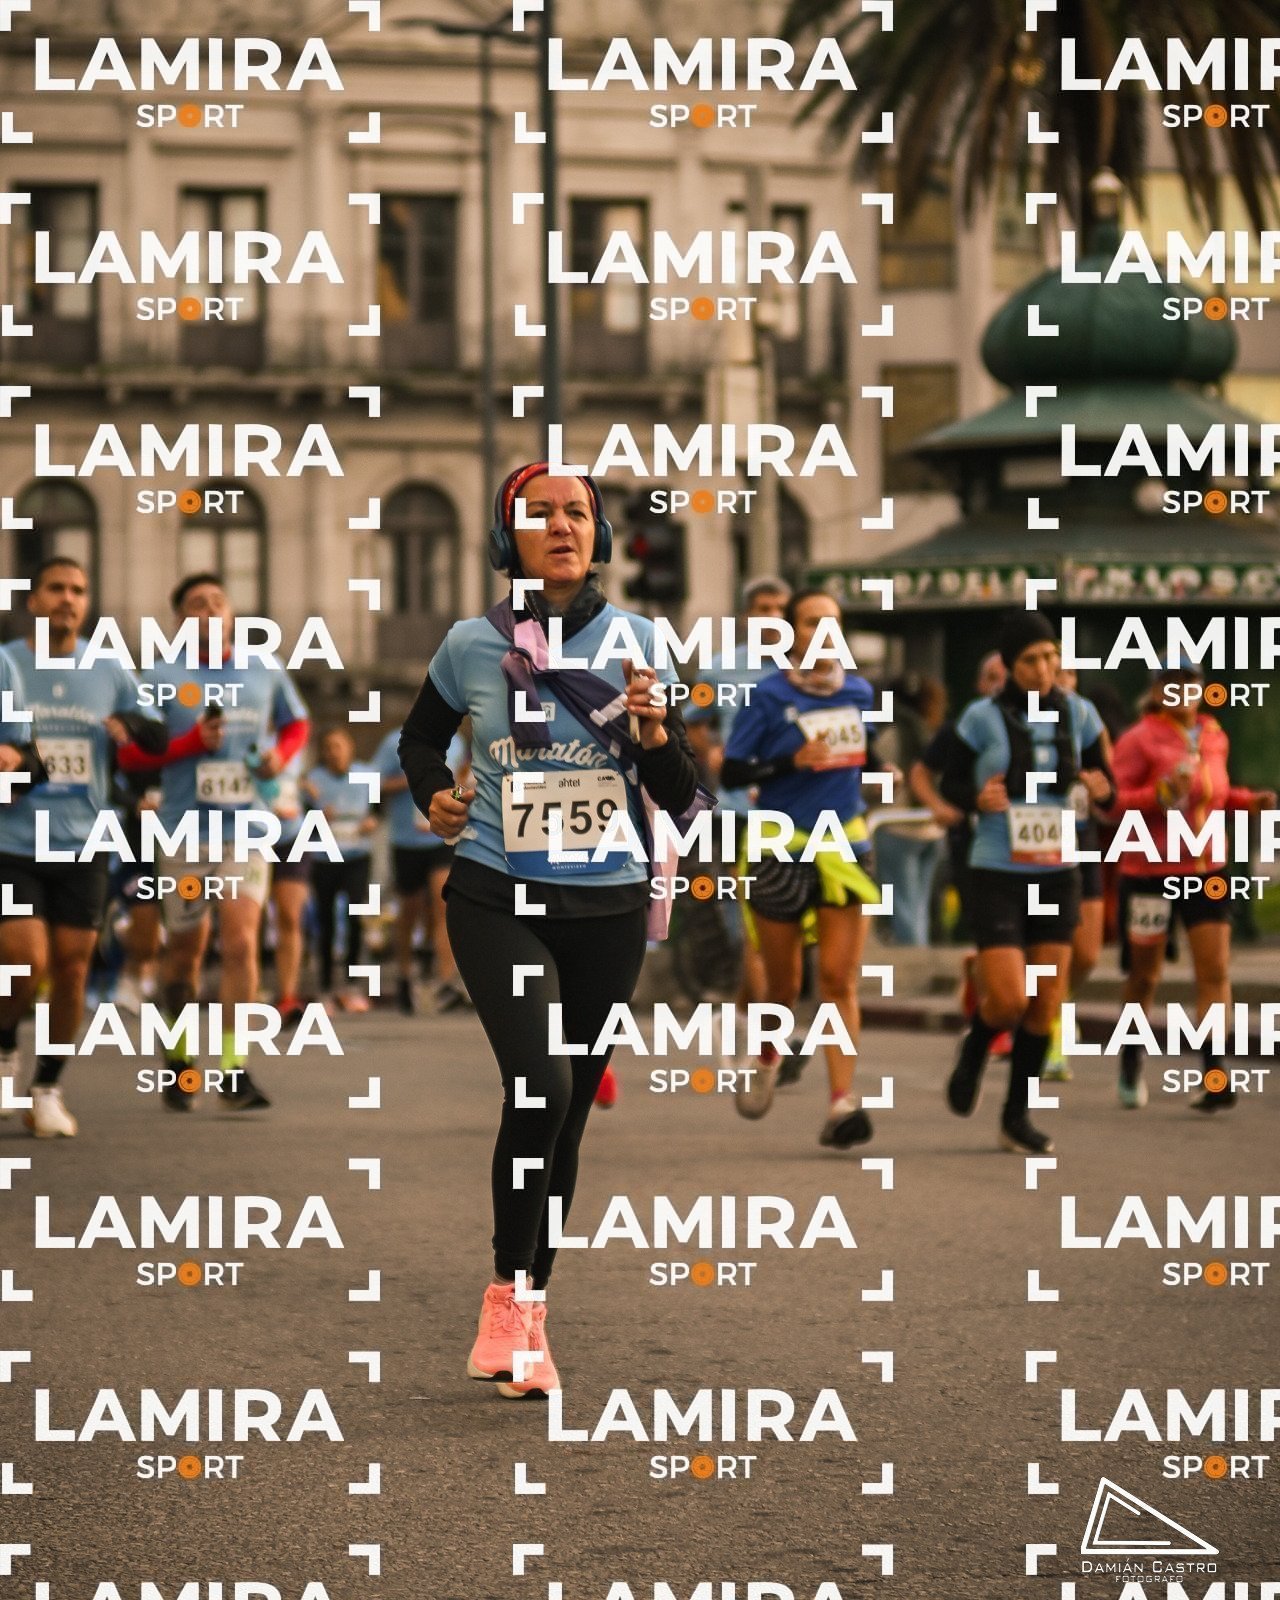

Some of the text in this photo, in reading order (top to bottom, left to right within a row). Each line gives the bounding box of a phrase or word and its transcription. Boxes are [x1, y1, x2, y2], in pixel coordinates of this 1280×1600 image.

[816, 723, 861, 746] 045
[511, 798, 619, 838] 7559
[1018, 822, 1063, 844] 404
